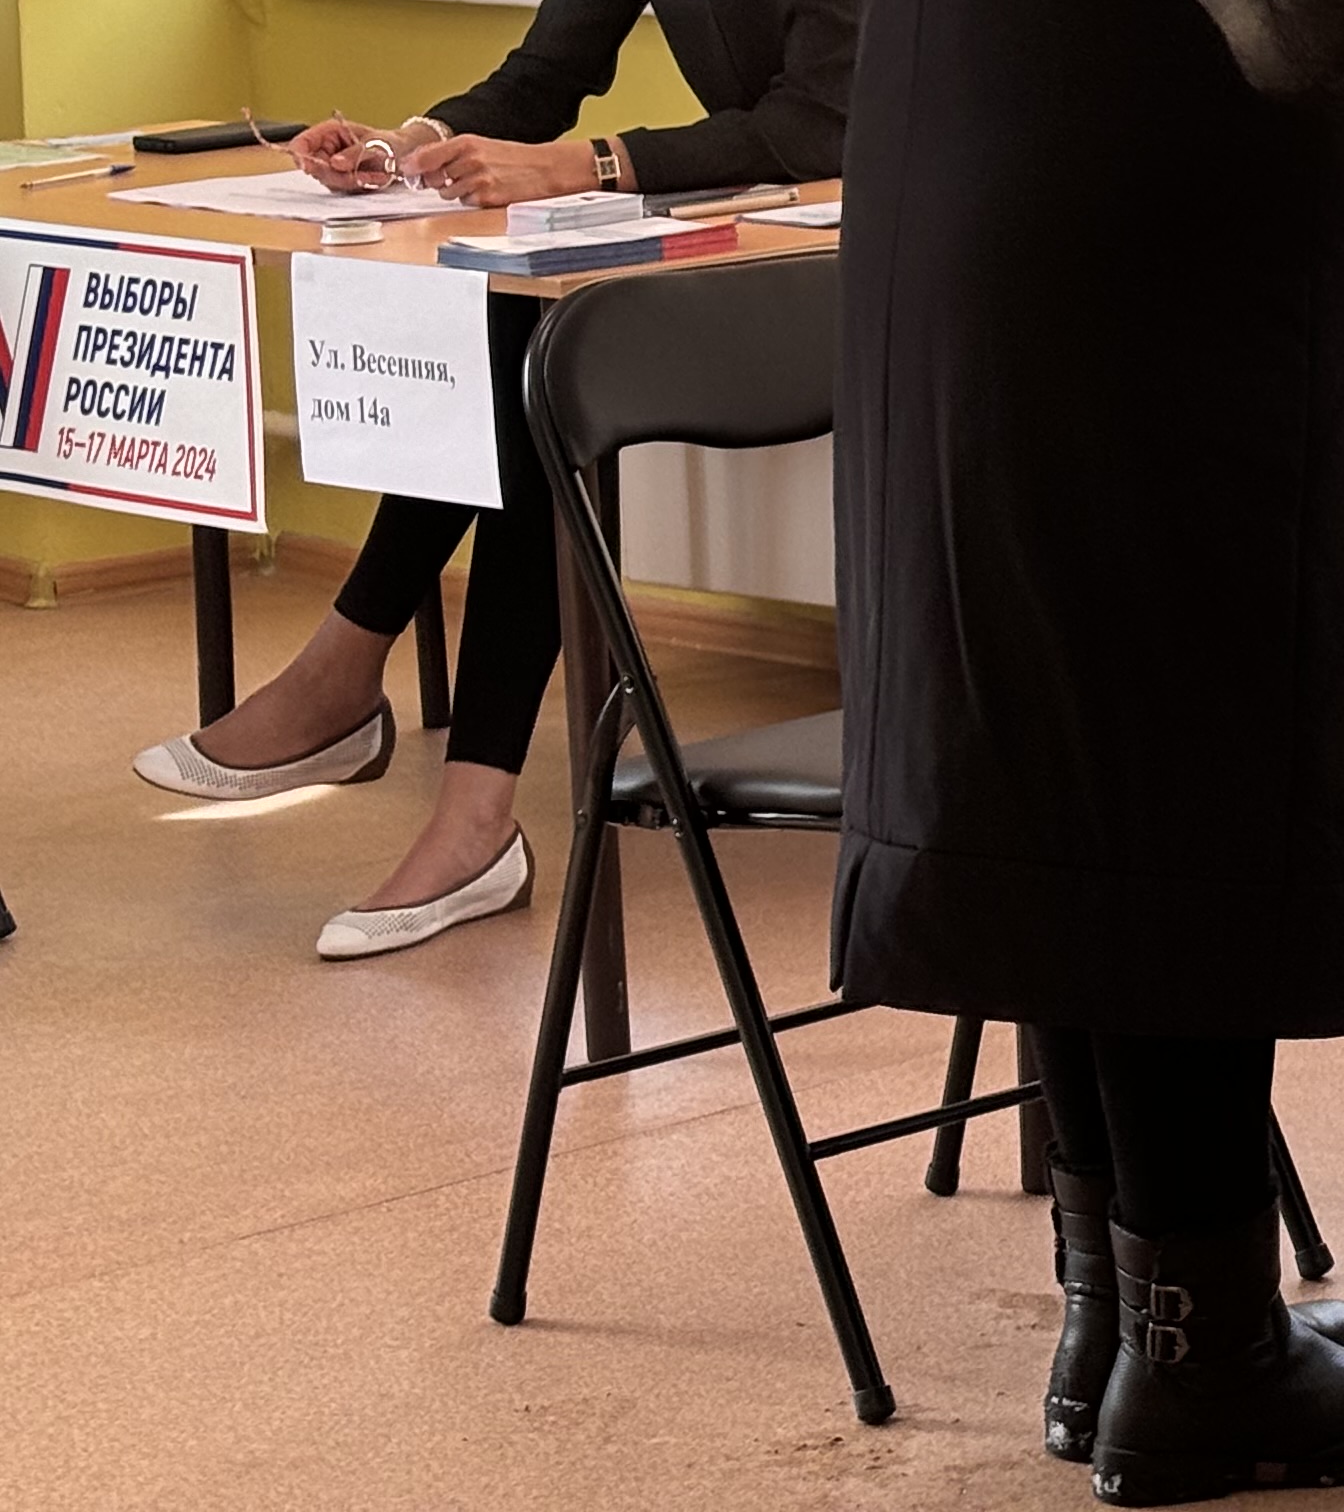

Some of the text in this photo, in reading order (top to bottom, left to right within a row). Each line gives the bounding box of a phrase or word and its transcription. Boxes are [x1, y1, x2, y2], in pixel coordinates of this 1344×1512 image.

[82, 271, 199, 322] ВЫБОРЫ
[72, 325, 236, 382] ПРЕЗИДЕНТА
[308, 339, 456, 389] Ул. Весенняя,
[62, 376, 167, 427] РОССИИ
[310, 395, 391, 428] дом 14а
[106, 433, 168, 476] МАРТА
[171, 443, 217, 483] 2024
